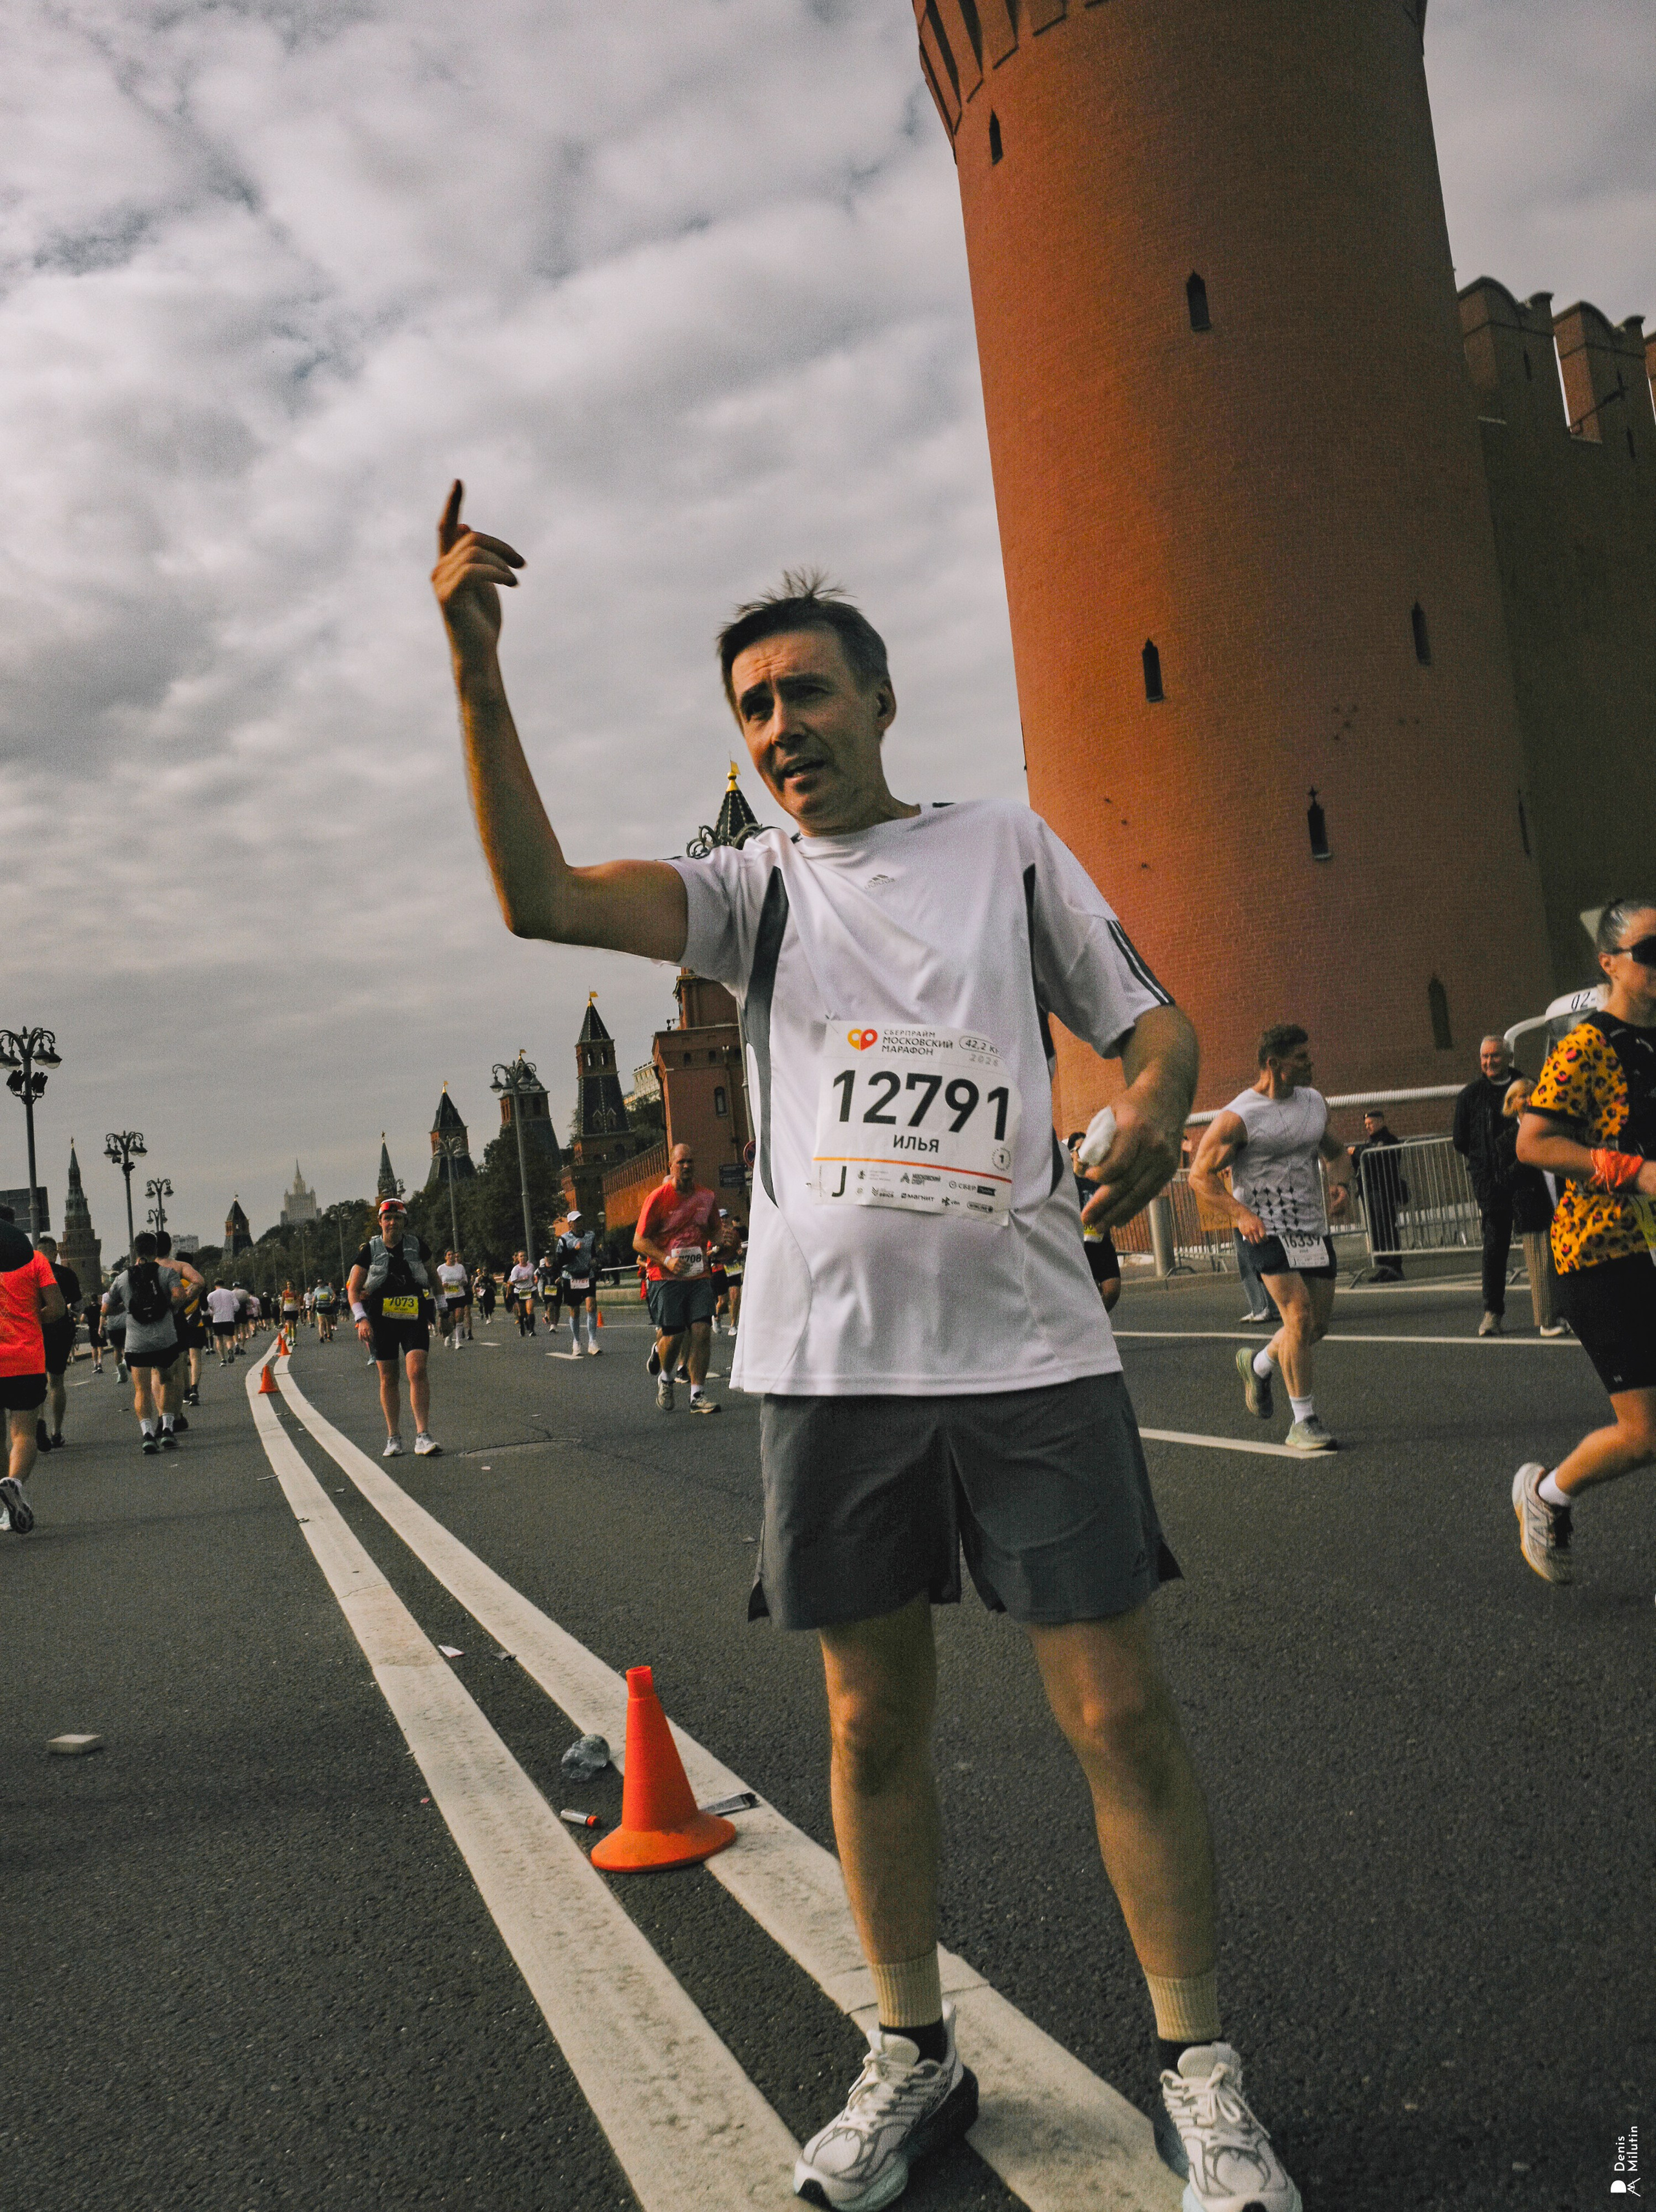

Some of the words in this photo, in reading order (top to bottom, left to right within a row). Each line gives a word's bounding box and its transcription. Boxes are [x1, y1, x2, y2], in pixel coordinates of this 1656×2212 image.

[882, 1036, 953, 1049] МОСКОВСКИЙ
[882, 1045, 933, 1056] МАРАФОН
[833, 1069, 1009, 1141] 12791
[893, 1135, 939, 1153] ИЛЬЯ
[832, 1166, 847, 1197] J
[389, 1297, 414, 1308] 7073
